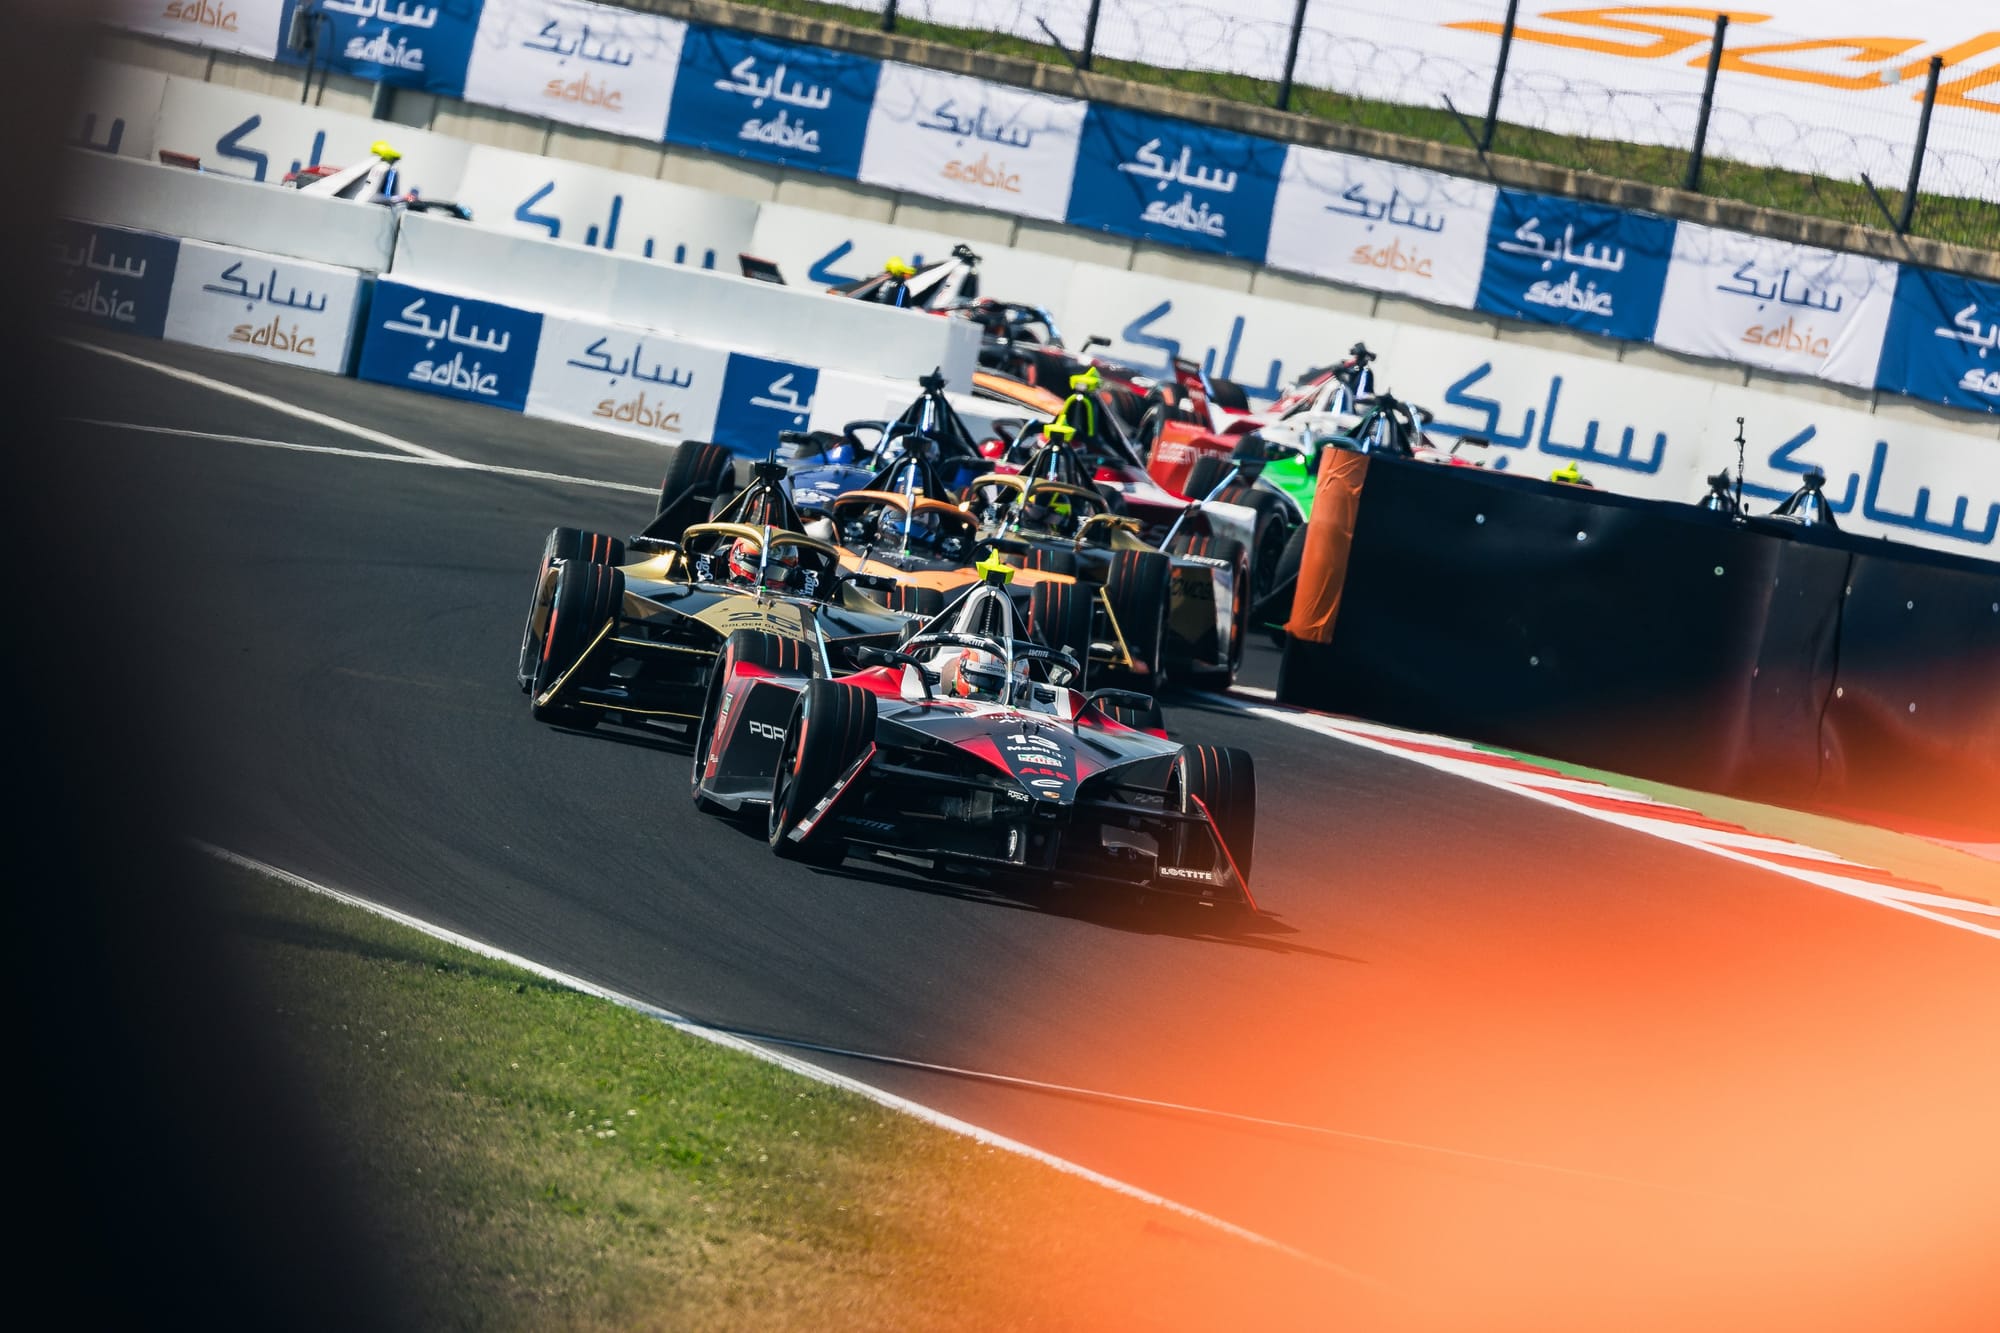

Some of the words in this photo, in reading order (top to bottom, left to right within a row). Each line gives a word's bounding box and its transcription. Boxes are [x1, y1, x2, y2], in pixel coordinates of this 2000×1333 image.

[344, 27, 425, 71] sabic
[523, 20, 633, 66] سابك
[543, 71, 624, 111] sabic
[714, 56, 831, 109] سابك
[738, 110, 821, 153] sabic
[917, 99, 1033, 148] سابك
[940, 154, 1022, 194] sabic
[1117, 138, 1237, 192] سابك
[1140, 192, 1226, 238] sabic
[1325, 182, 1445, 233] سابك
[1350, 237, 1433, 279] sabic
[1497, 217, 1625, 272] سابك
[203, 261, 326, 312] سابك
[1524, 271, 1613, 317] sabic
[1716, 260, 1843, 313] سابك
[228, 315, 316, 356] sabic
[383, 298, 510, 353] سابك
[1740, 315, 1830, 359] sabic
[408, 352, 499, 396] sabic
[567, 337, 693, 388] سابك
[592, 392, 682, 433] sabic
[1420, 361, 1668, 475] سابك
[1006, 745, 1050, 754] Mobil
[1007, 734, 1060, 751] 13
[1007, 789, 1030, 802] PORSCHE
[1161, 867, 1212, 881] LOCTITE
